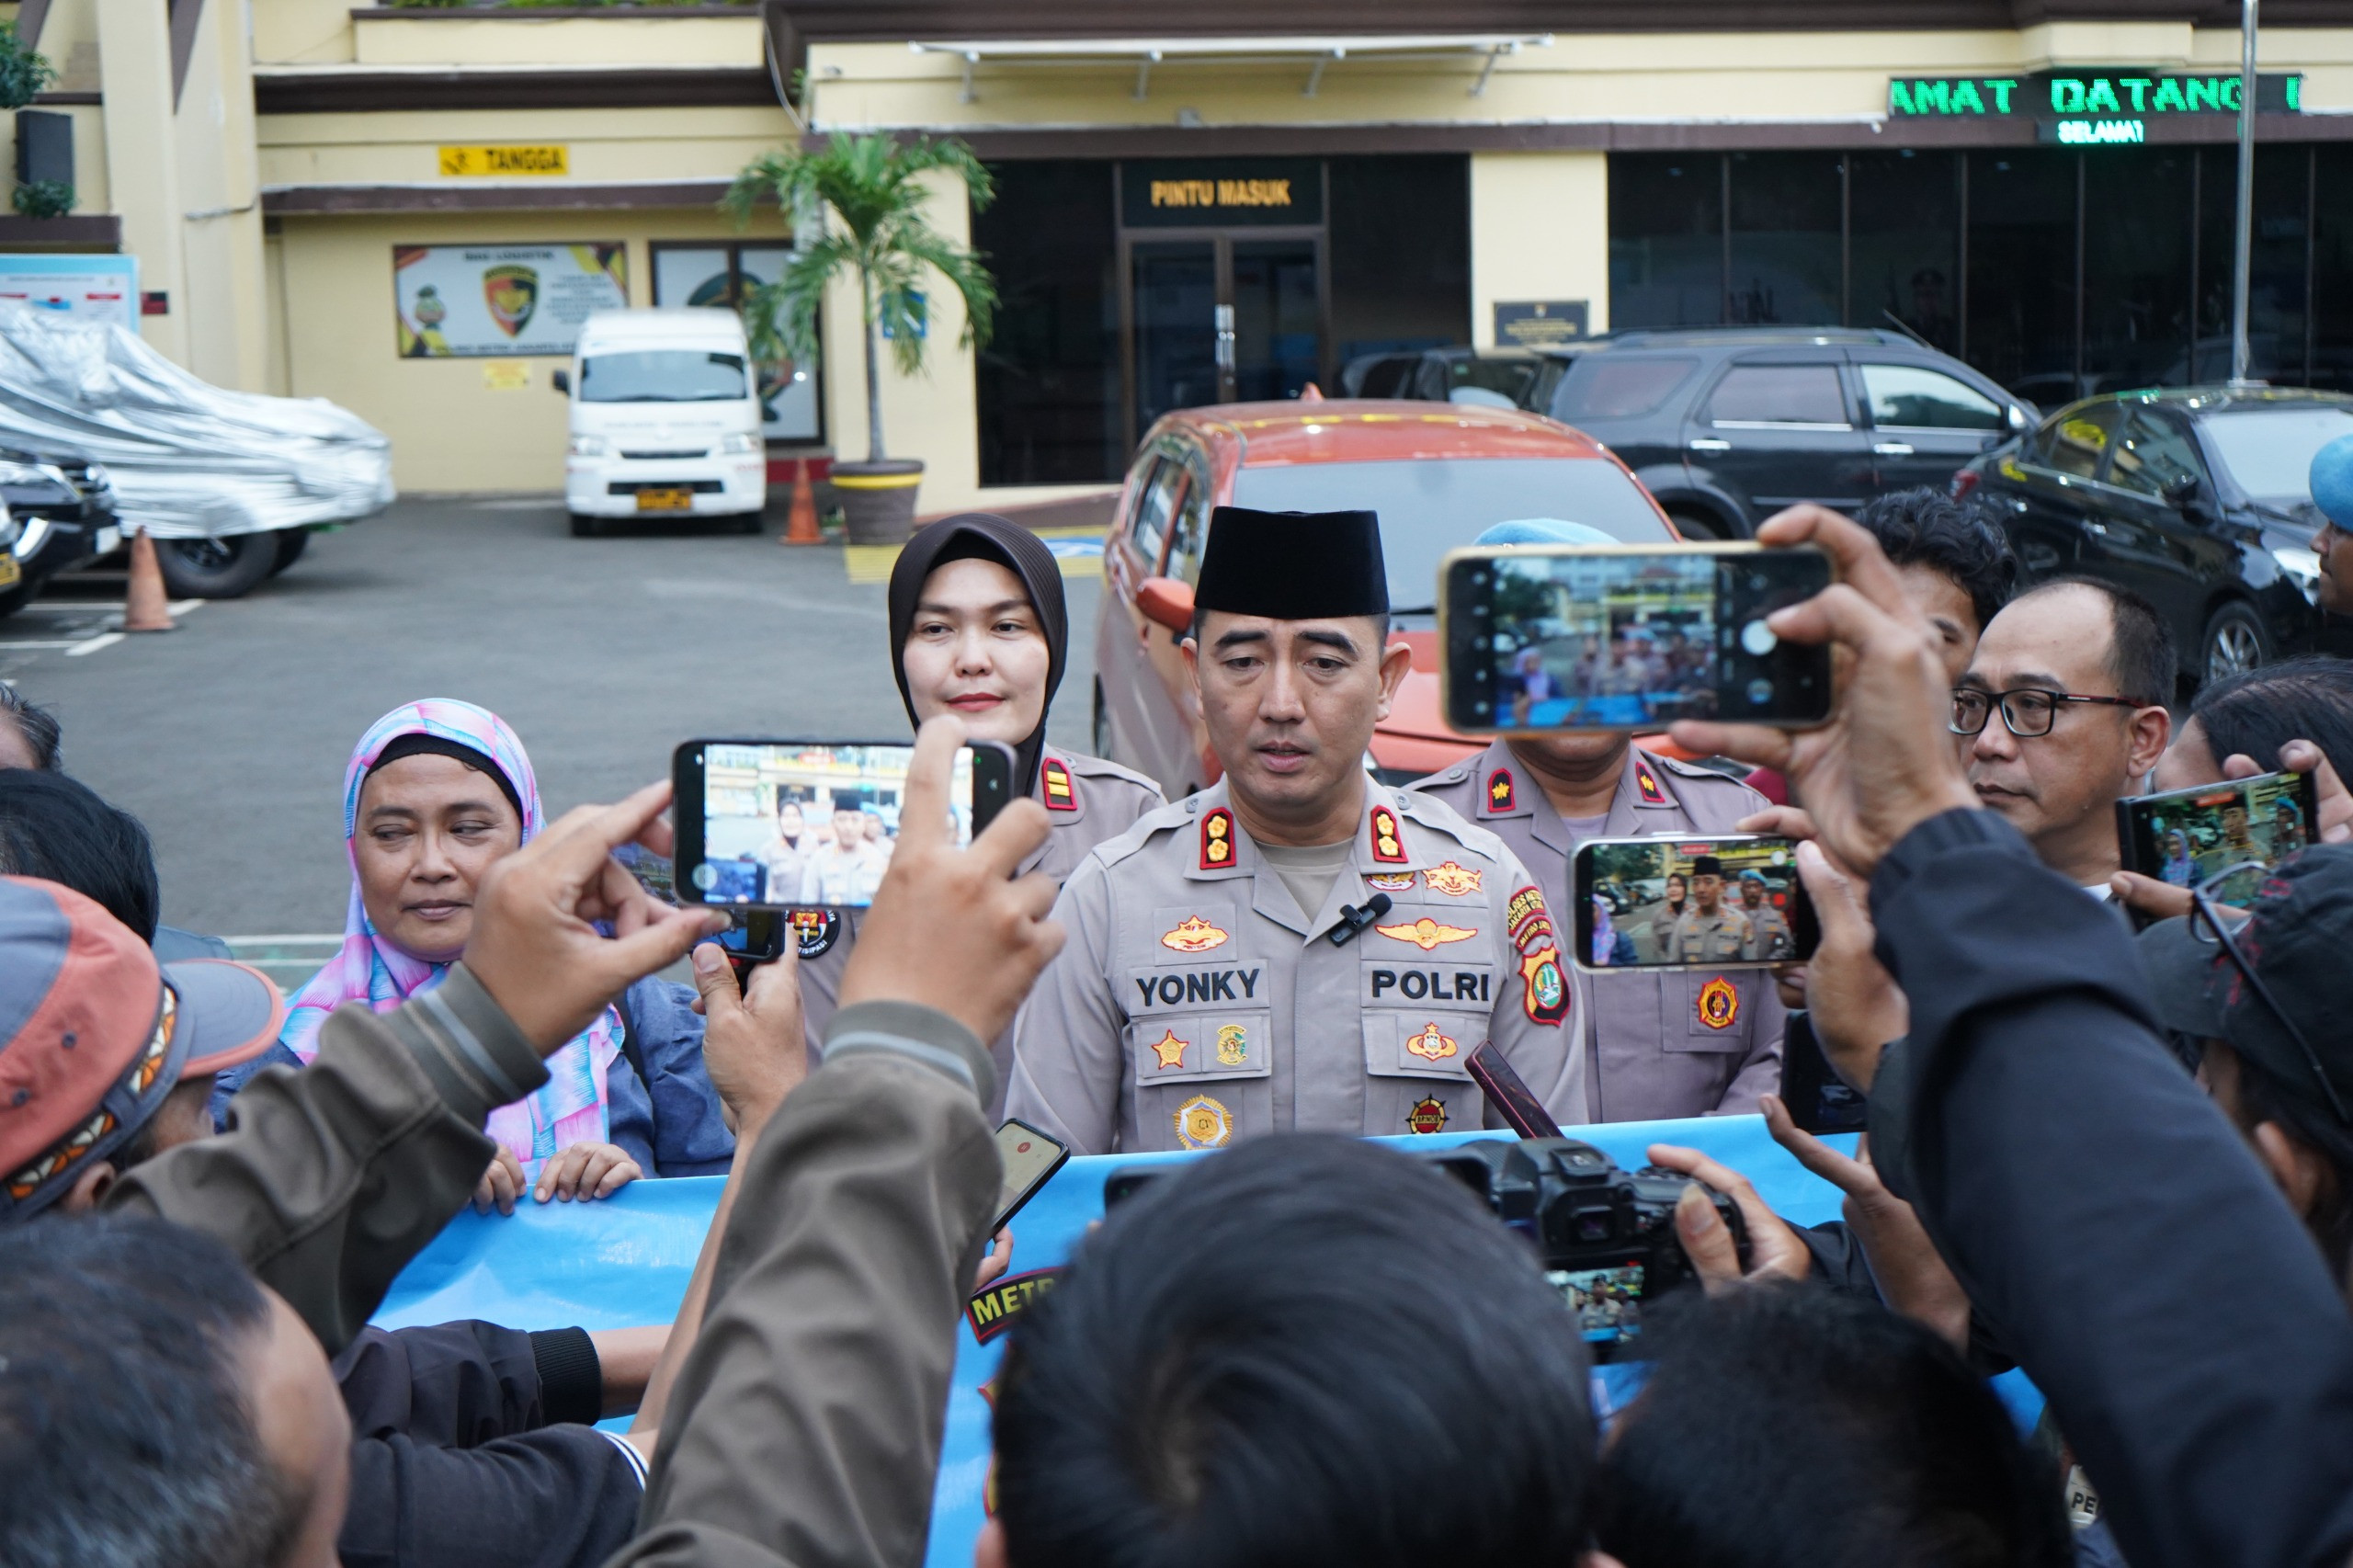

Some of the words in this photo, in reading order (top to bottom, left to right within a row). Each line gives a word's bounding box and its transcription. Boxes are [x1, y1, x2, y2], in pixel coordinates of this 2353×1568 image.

[486, 148, 563, 172] TANGGA
[1151, 179, 1215, 208] PINTU
[1217, 178, 1291, 207] MASUK
[1508, 894, 1527, 919] OLRES
[1136, 968, 1260, 1007] YONKY
[1372, 970, 1489, 1001] POLRI
[2071, 1491, 2099, 1515] PE
